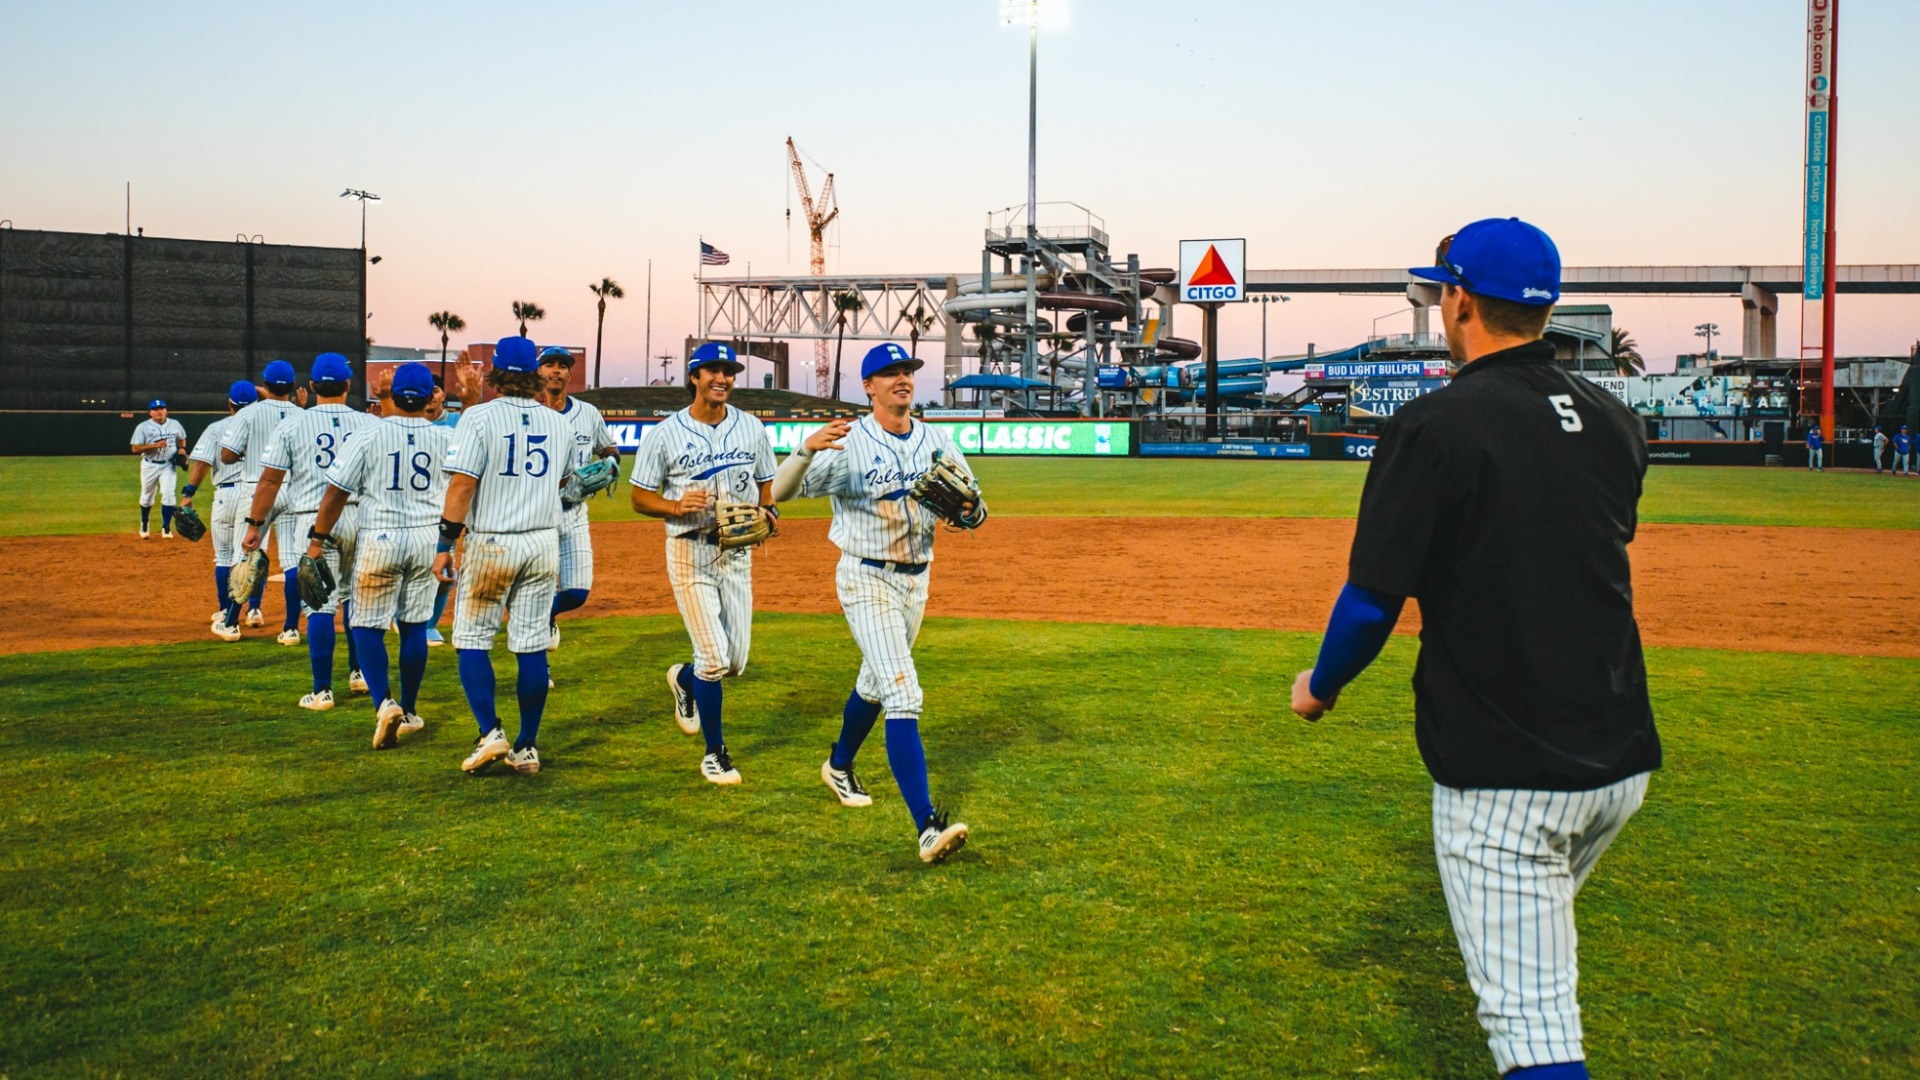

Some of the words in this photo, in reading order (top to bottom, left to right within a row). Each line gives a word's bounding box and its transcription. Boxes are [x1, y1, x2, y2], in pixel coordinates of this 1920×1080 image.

[1813, 15, 1825, 74] heb.com
[1813, 115, 1824, 161] curbside
[1810, 165, 1821, 202] pickup
[1811, 219, 1821, 250] home
[1187, 286, 1236, 300] CITGO
[1808, 253, 1820, 296] delivery
[1328, 365, 1347, 376] BUD
[1349, 364, 1377, 375] LIGHT
[1378, 363, 1421, 375] BULLPEN
[1548, 393, 1584, 433] 5
[1631, 396, 1709, 408] POWER
[1727, 396, 1785, 408] PLAY
[315, 432, 353, 469] 3
[499, 433, 549, 478] 15
[959, 426, 1072, 450] CLASSIC
[386, 451, 431, 491] 18
[679, 447, 756, 470] Islanders
[735, 471, 750, 492] 3
